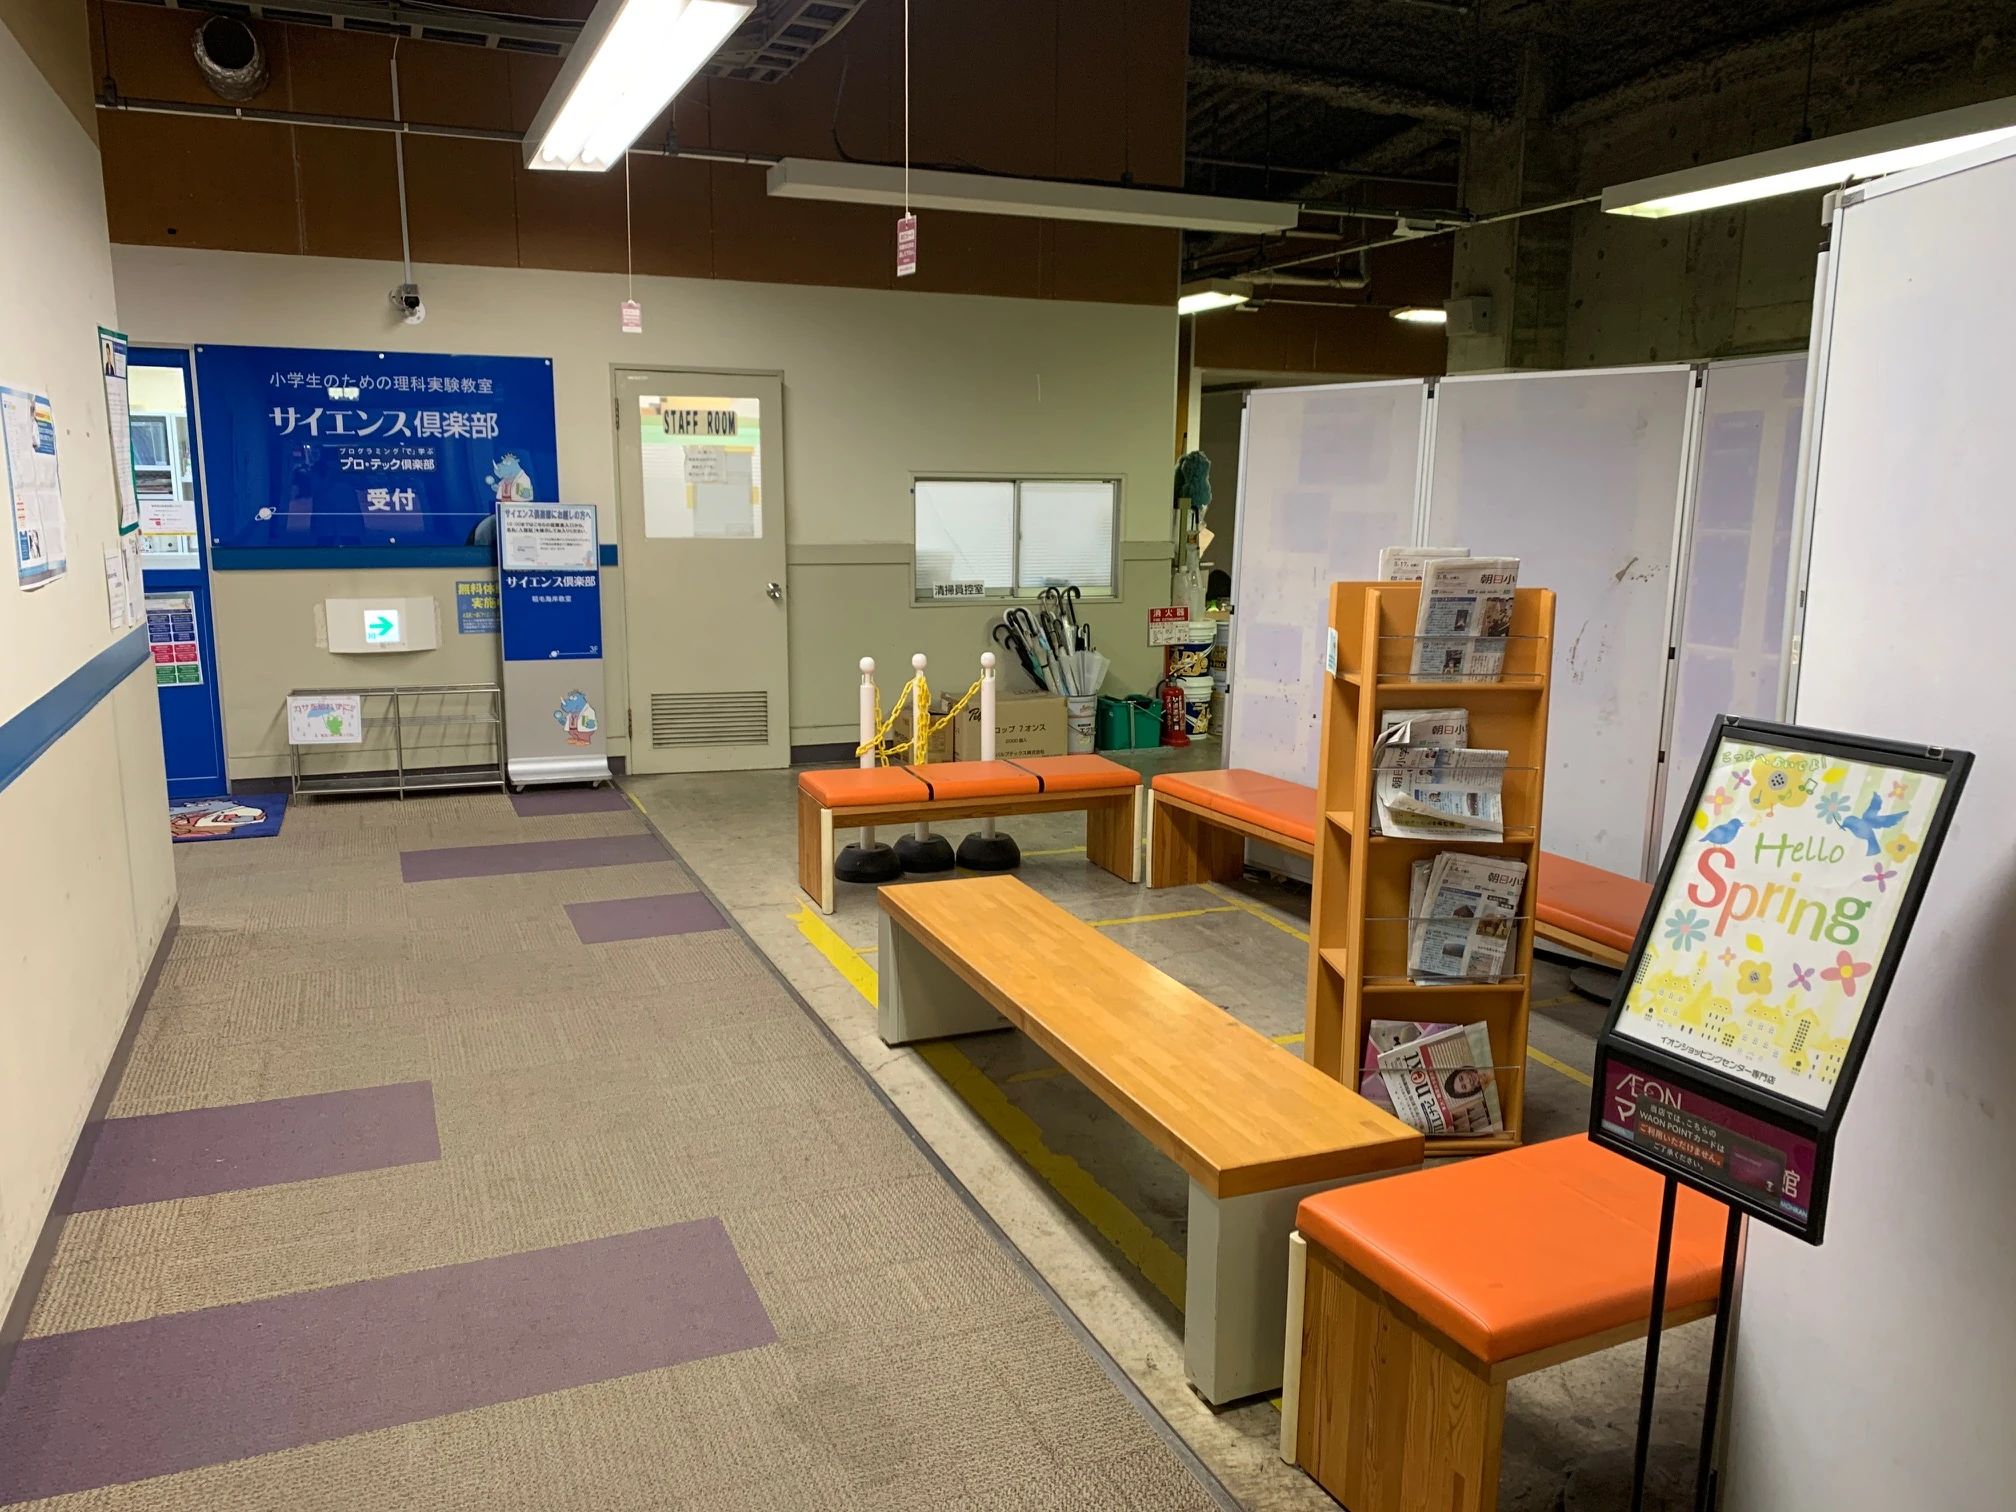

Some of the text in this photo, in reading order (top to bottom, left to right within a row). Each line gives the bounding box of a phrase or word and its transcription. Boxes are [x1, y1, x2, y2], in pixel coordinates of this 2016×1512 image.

[270, 372, 494, 394] 小学生のための理科実験教室
[269, 407, 499, 439] サイエンス倶楽部
[664, 410, 736, 435] STAFF ROOM
[340, 457, 435, 471] プロ・テック倶楽部
[367, 488, 416, 511] 受付
[506, 576, 597, 588] サイエンス倶楽部
[934, 584, 984, 596] 清掃員控室
[1152, 608, 1185, 618] 消火器
[1754, 832, 1845, 865] Hello
[1687, 847, 1872, 946] Spring
[1661, 1036, 1776, 1084] イオンショッピングセンター専門店
[1639, 1112, 1668, 1129] WAON
